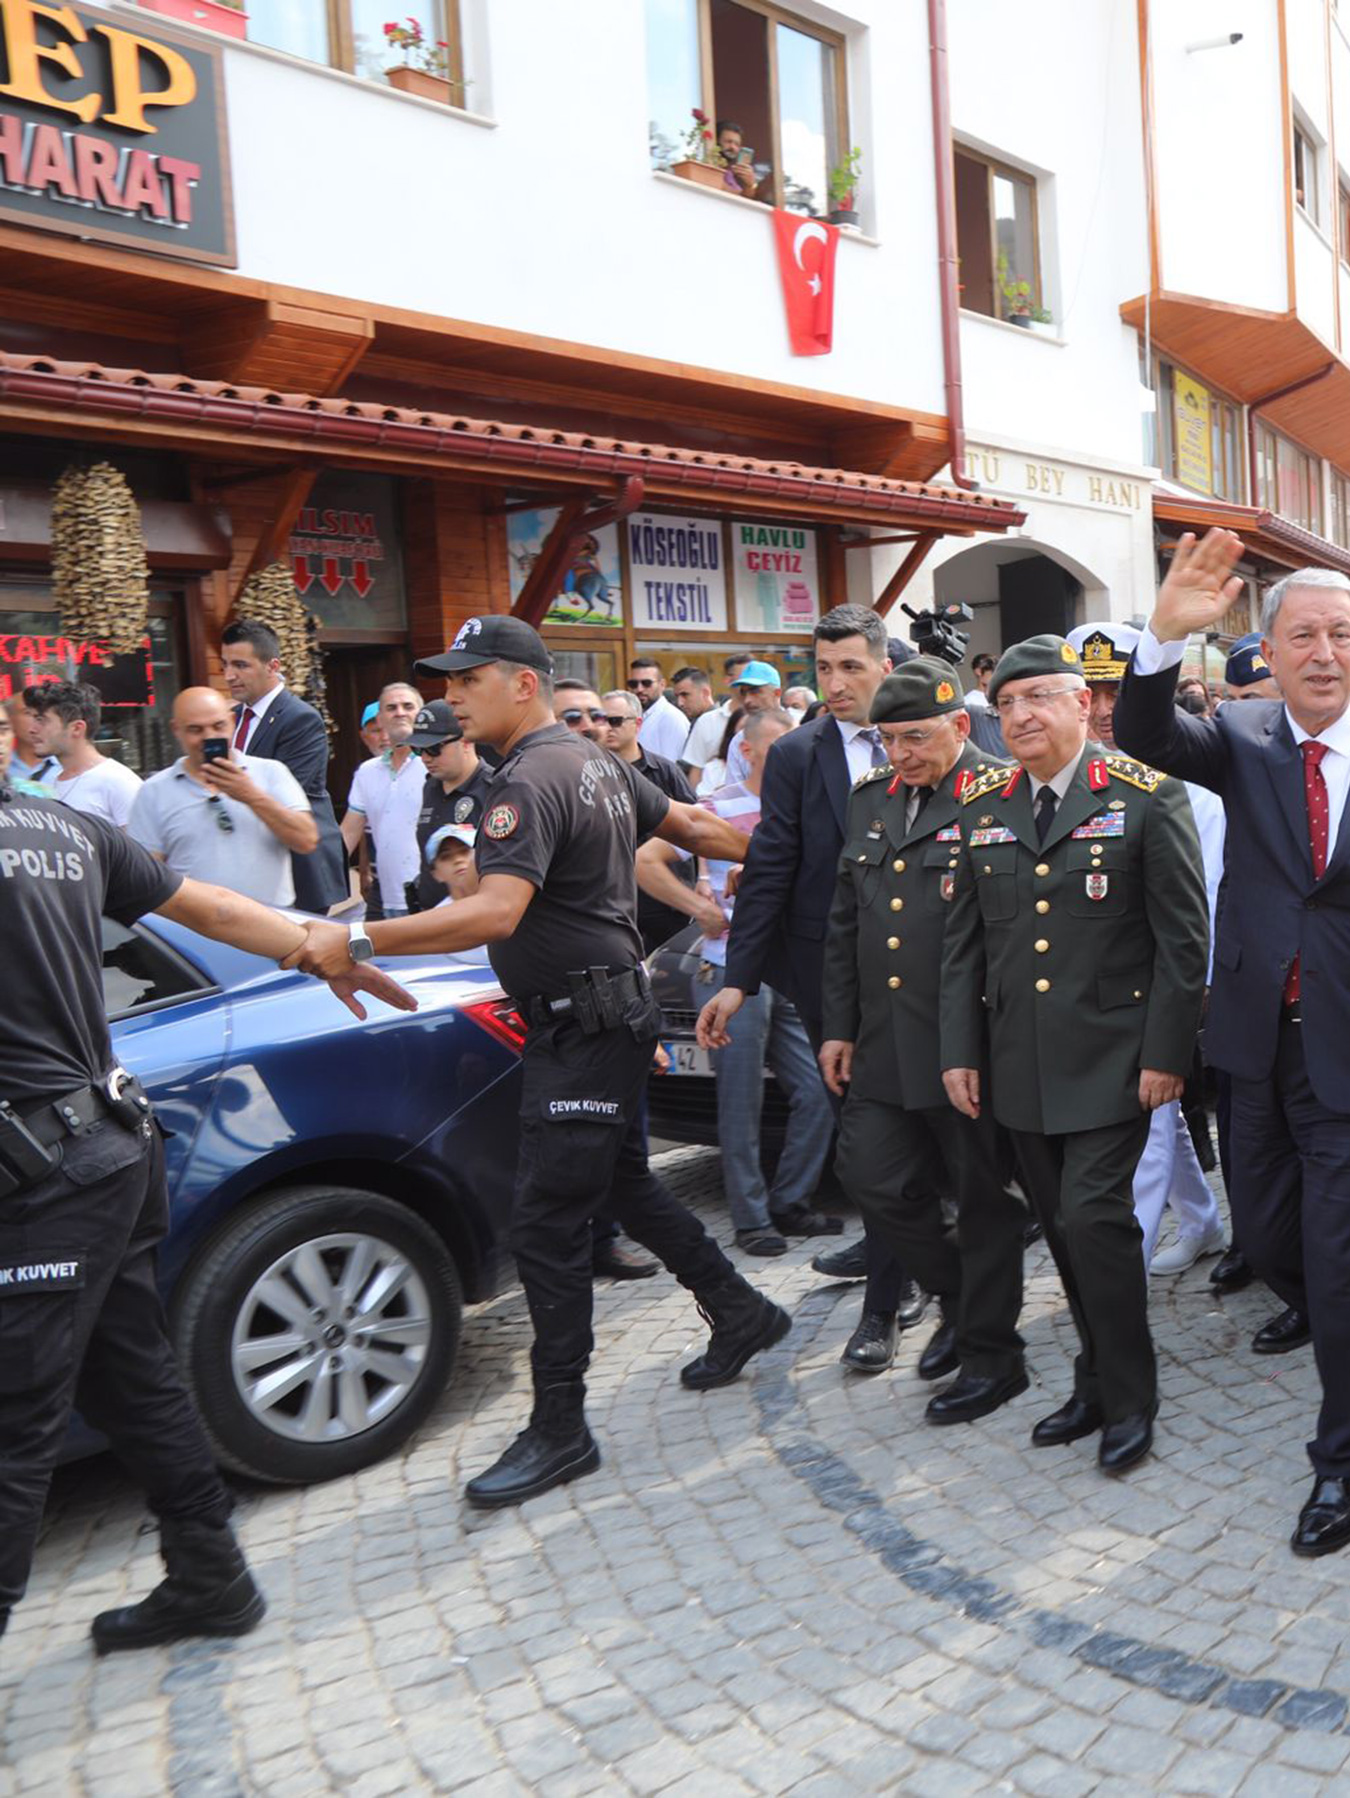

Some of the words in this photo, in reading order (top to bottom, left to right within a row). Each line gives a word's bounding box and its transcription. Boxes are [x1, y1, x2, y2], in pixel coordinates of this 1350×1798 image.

[1026, 463, 1065, 495] BEY
[1088, 476, 1141, 510] HANI
[630, 517, 719, 570] KÖSEOĞLU
[740, 525, 806, 549] HAVLU
[746, 551, 802, 573] ÇEYİZ
[644, 577, 712, 623] TEKSTİL
[10, 807, 95, 861] KUVVET
[582, 1099, 619, 1115] KUVVET
[17, 1261, 79, 1281] KUVVET
